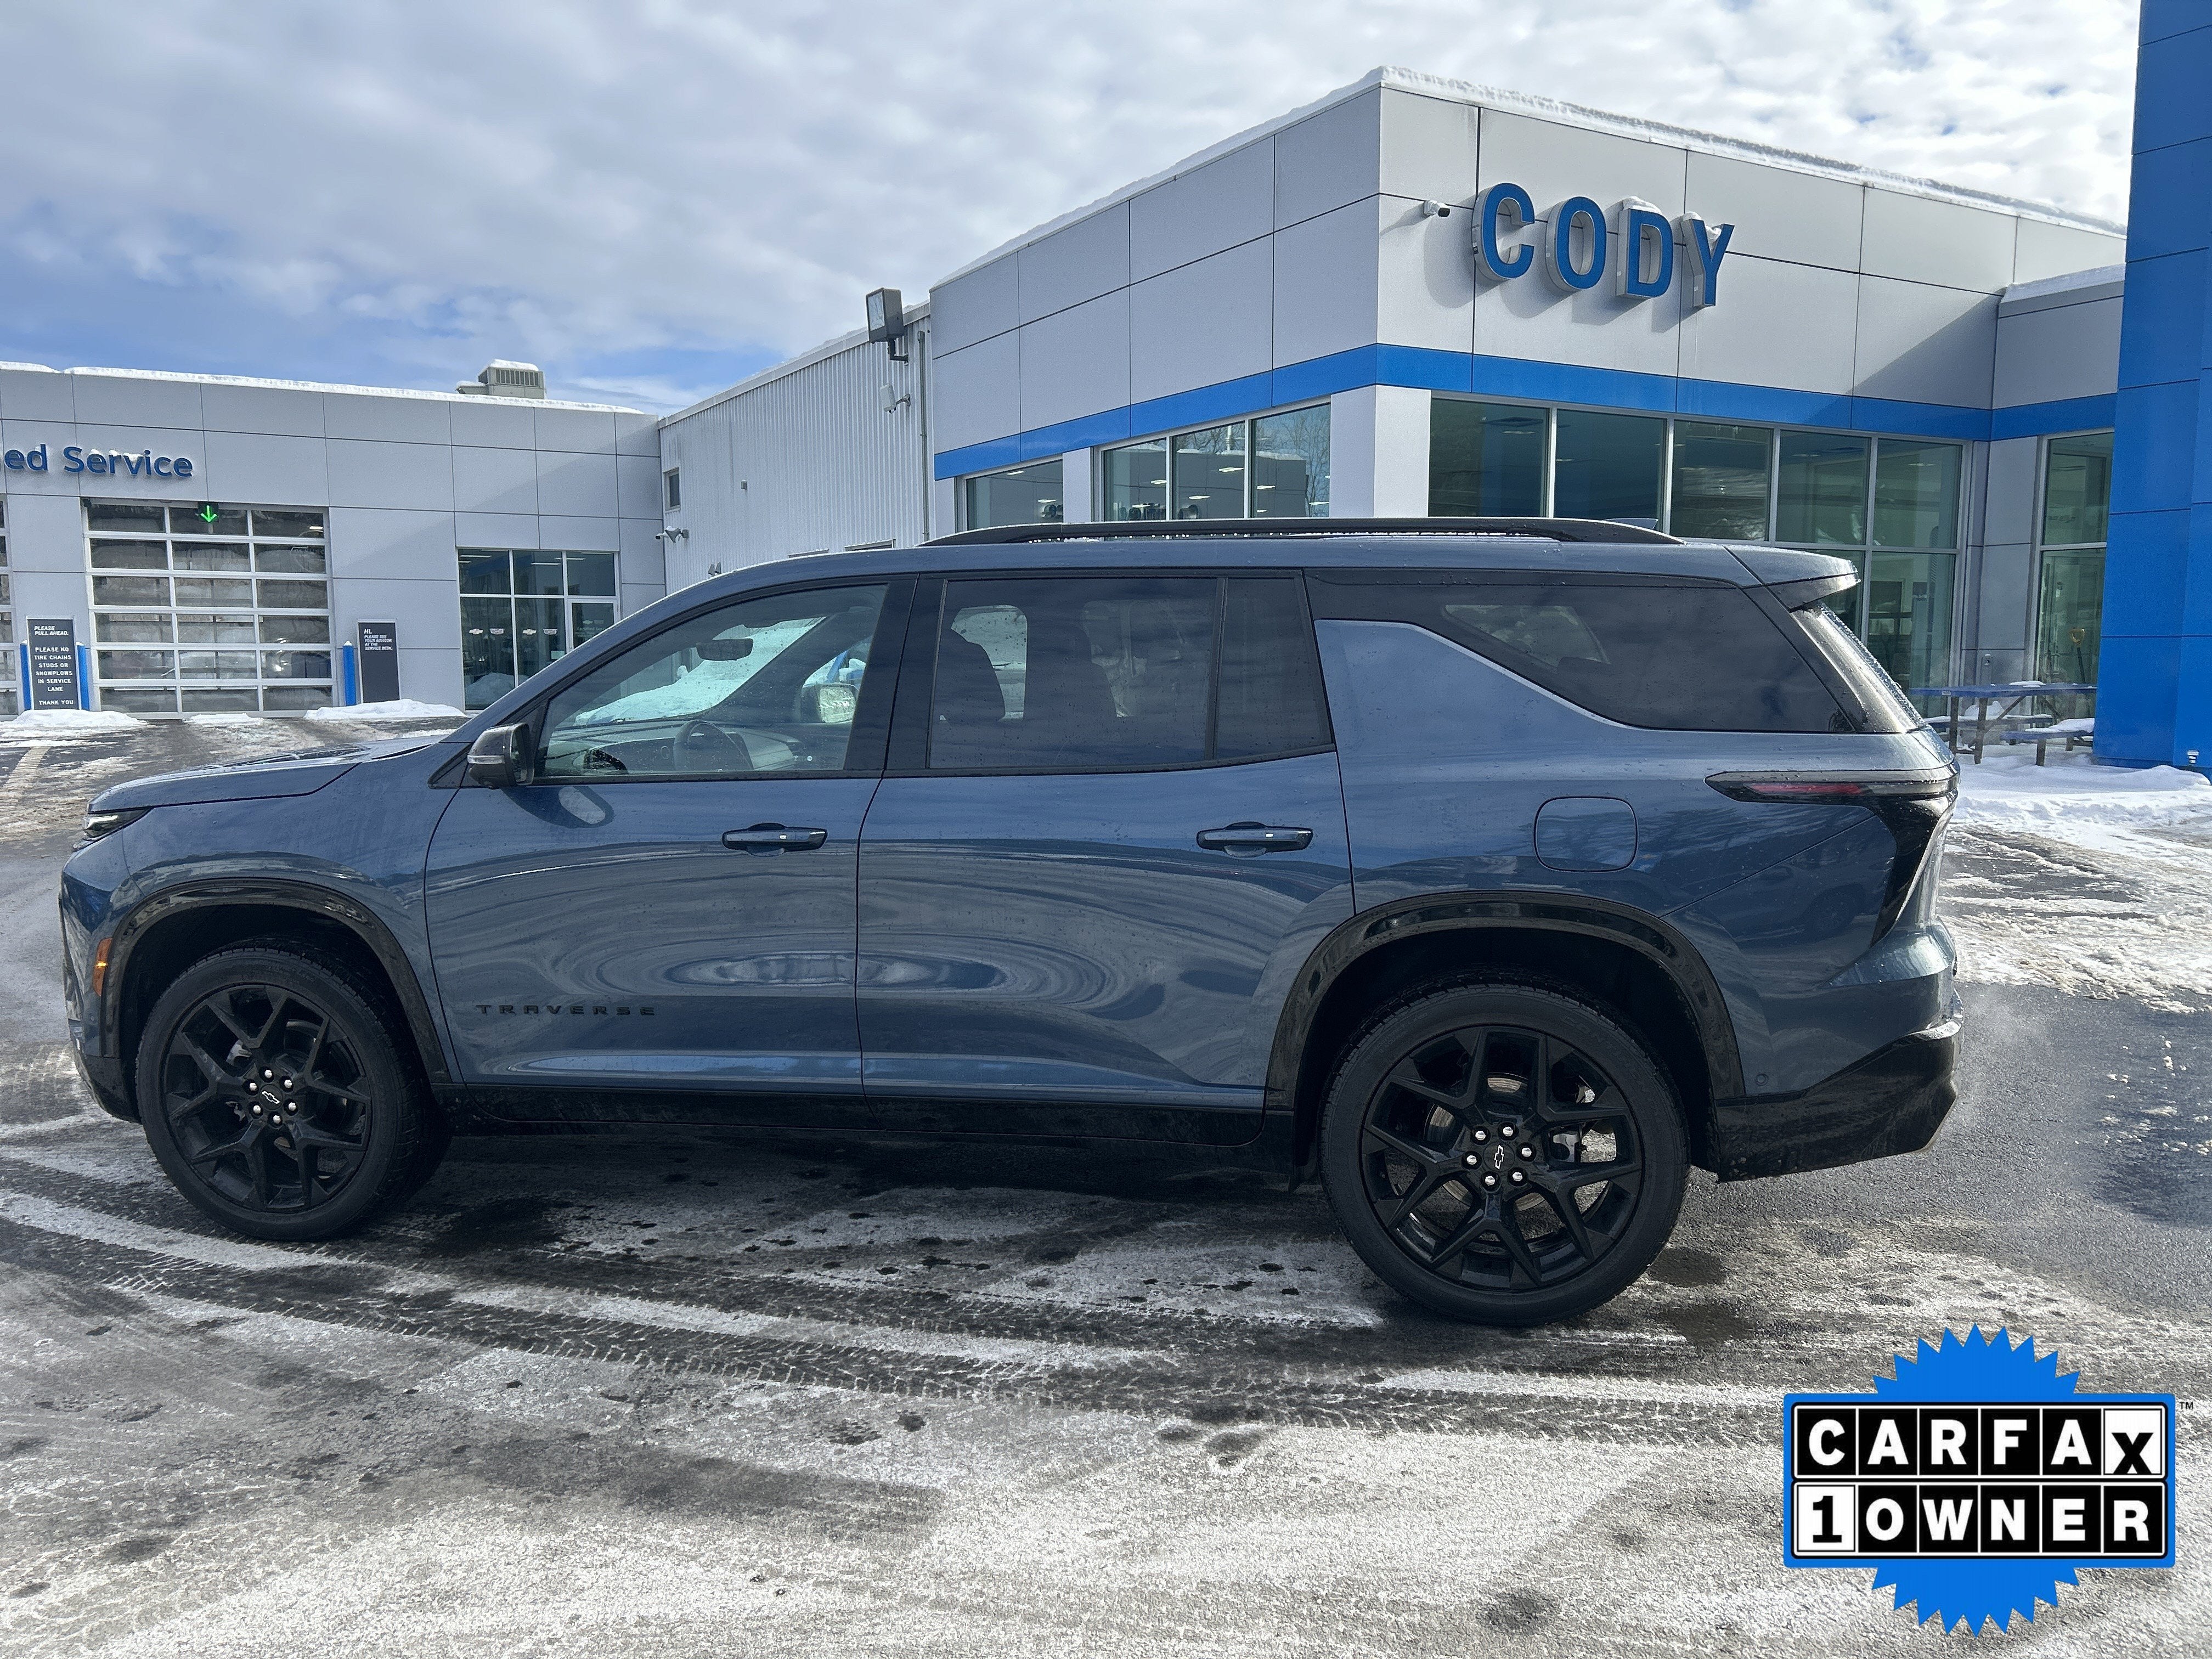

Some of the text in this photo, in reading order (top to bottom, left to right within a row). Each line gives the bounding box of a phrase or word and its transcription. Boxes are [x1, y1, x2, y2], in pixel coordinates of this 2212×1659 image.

[1472, 183, 1735, 307] CODY
[63, 446, 193, 477] Service
[476, 1005, 655, 1016] TRAVERSE
